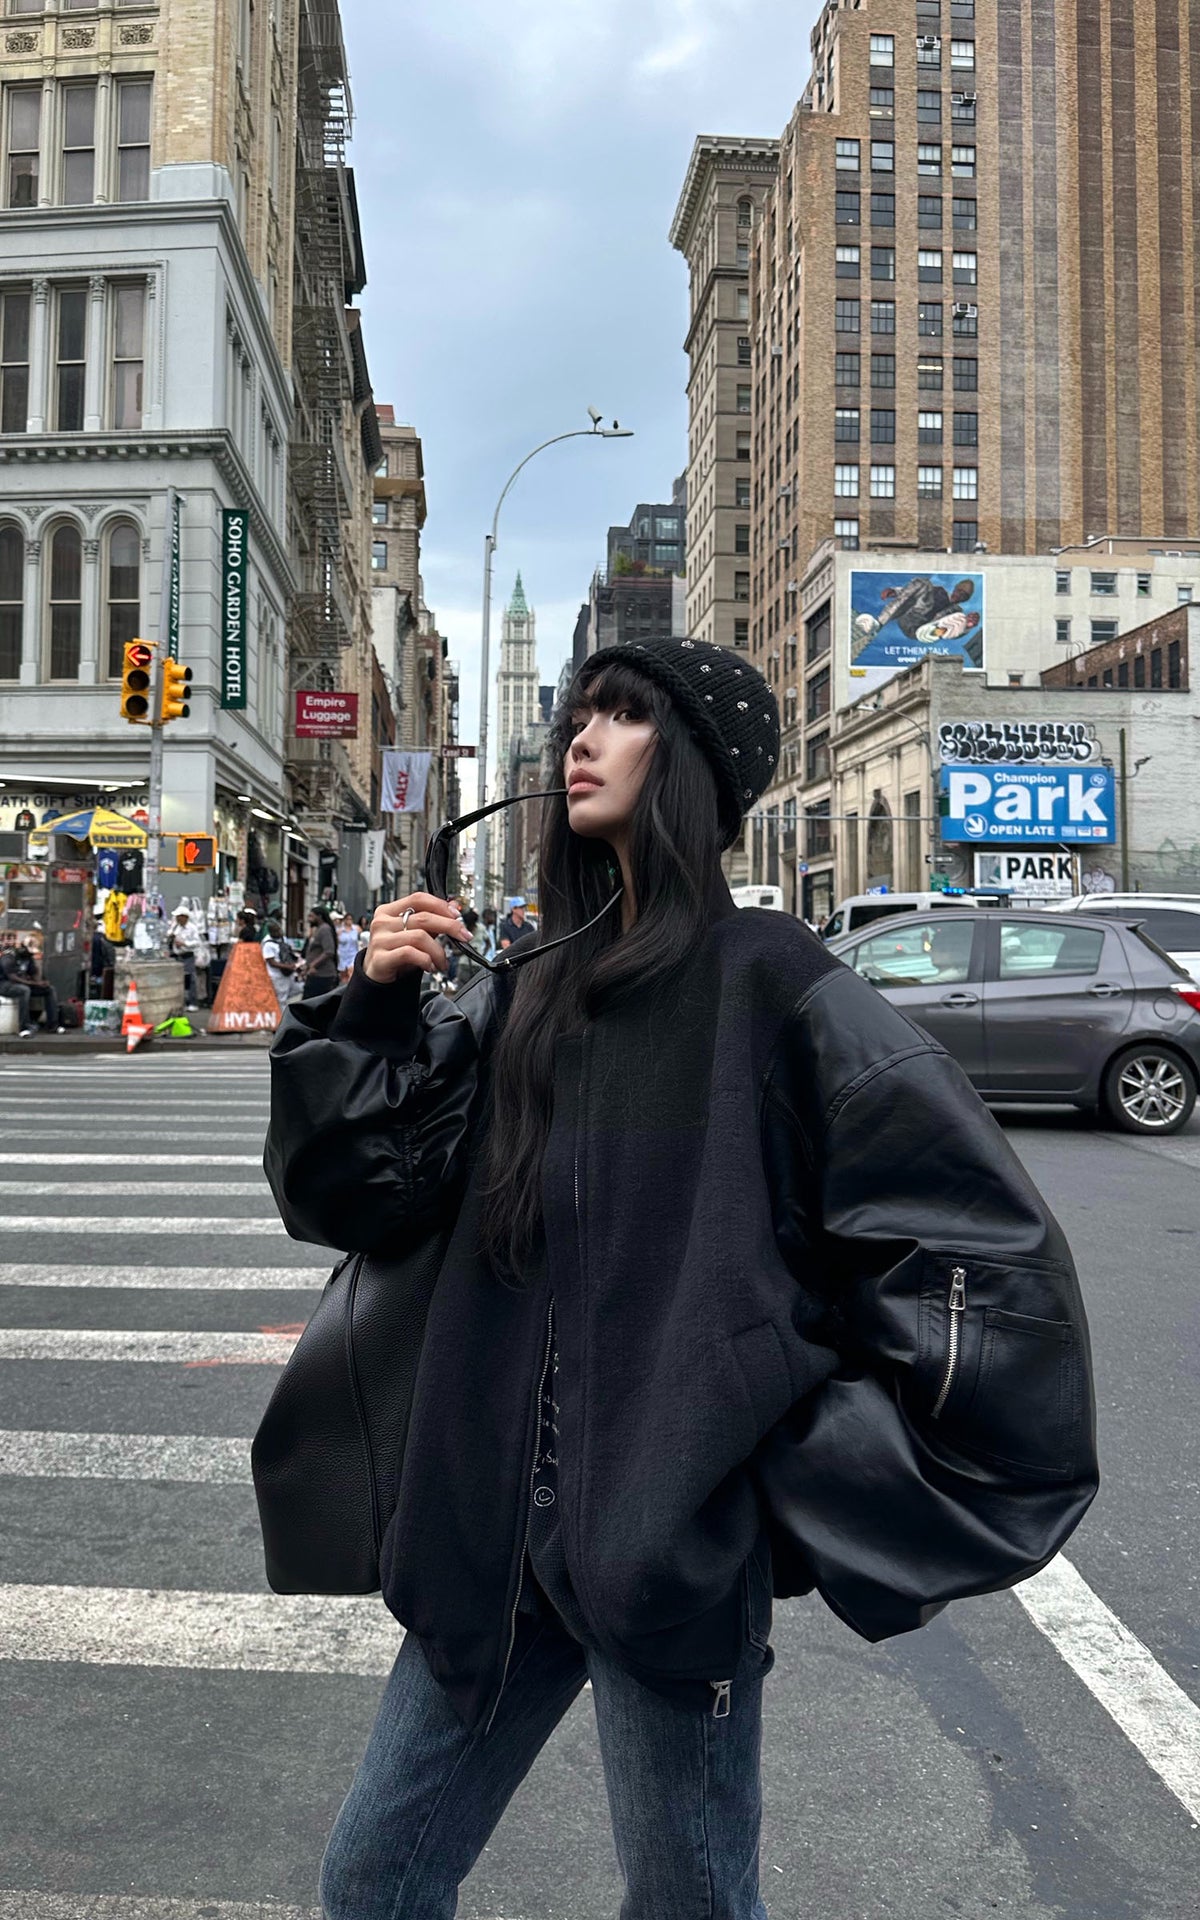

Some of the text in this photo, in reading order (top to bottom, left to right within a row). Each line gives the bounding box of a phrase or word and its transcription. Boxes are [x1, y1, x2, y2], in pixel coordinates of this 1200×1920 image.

[225, 516, 244, 701] SOHO GARDEN HOTEL
[884, 645, 950, 656] LET THEM TALK
[305, 695, 347, 709] Empire
[302, 709, 352, 723] Luggage
[993, 772, 1057, 785] Champion
[393, 770, 410, 810] SALLY
[949, 772, 1108, 822] Park
[33, 795, 67, 808] GIFT
[74, 794, 118, 808] SHOP
[121, 795, 149, 808] INC
[989, 825, 1022, 836] OPEN
[1024, 825, 1056, 837] LATE
[1006, 856, 1074, 880] PARK
[223, 1011, 277, 1029] HYLAN
